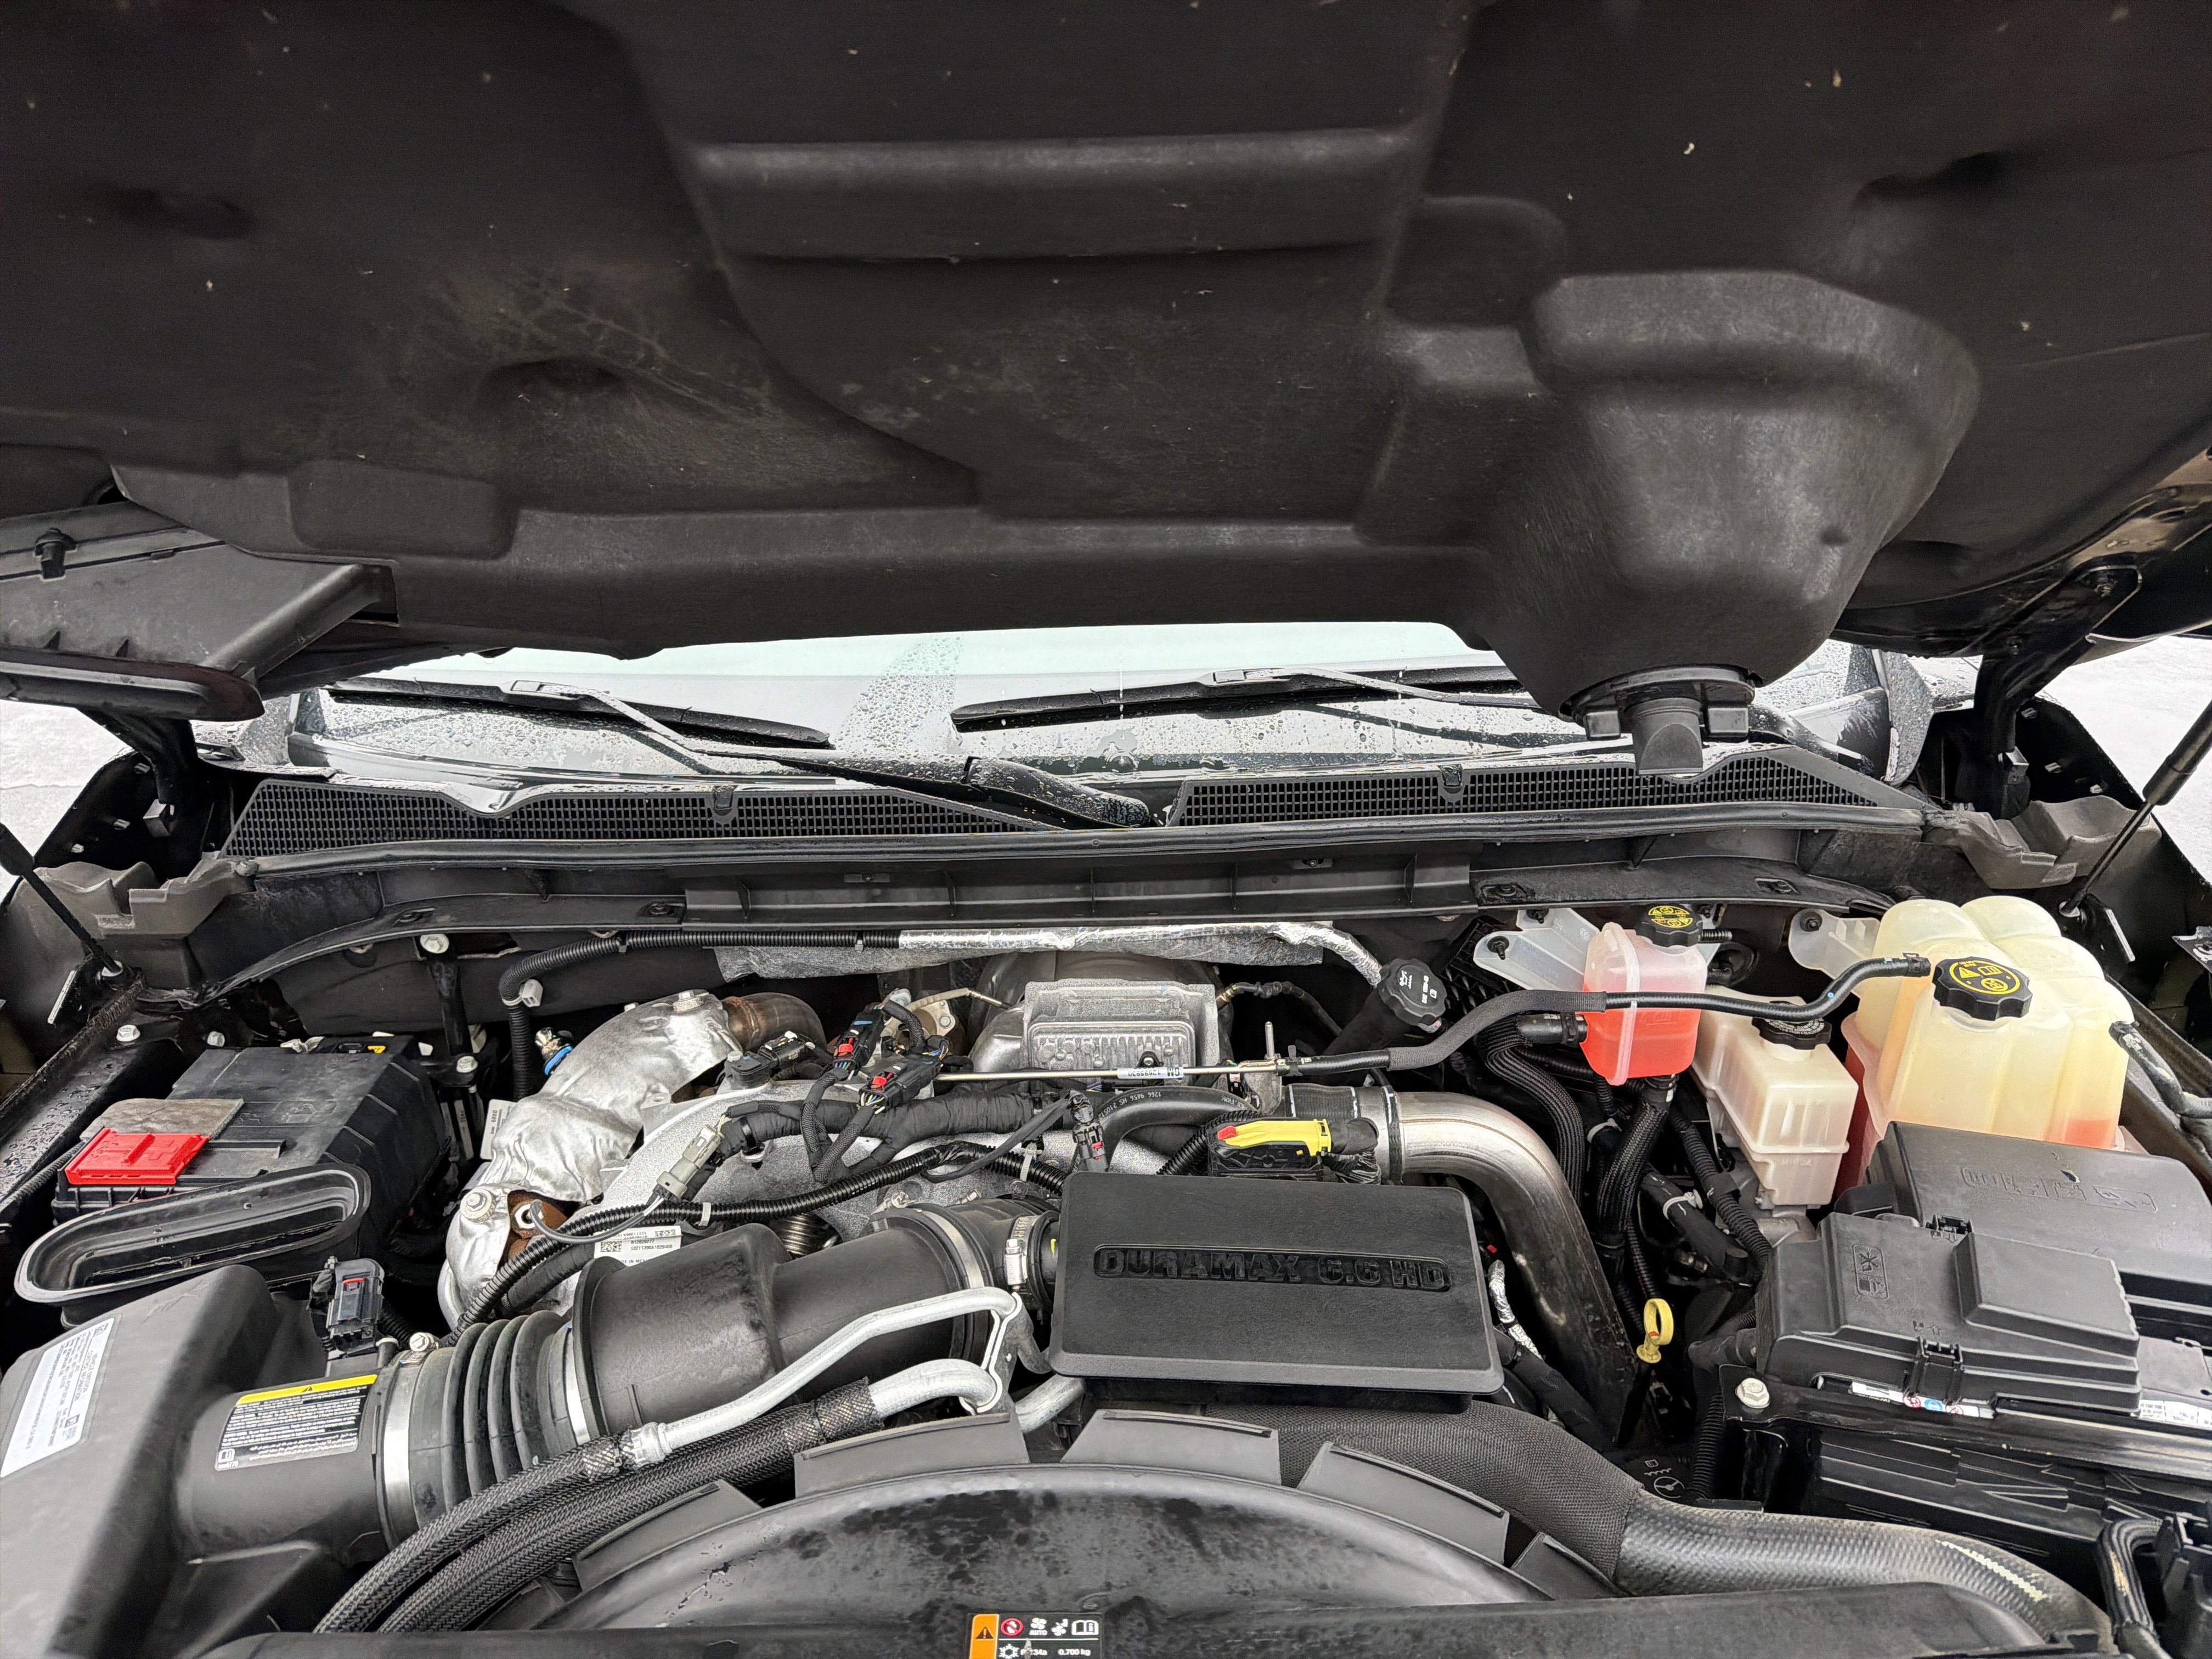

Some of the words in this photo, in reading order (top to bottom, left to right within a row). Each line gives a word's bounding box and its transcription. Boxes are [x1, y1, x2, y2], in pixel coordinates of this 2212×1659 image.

[1167, 1067, 1180, 1076] GM
[1119, 1097, 1127, 1105] HS
[1130, 1093, 1145, 1101] 9456
[1098, 1249, 1301, 1283] DURAMAX
[1317, 1258, 1381, 1284] 6.6
[1389, 1260, 1452, 1289] HD
[1080, 1649, 1091, 1657] kg
